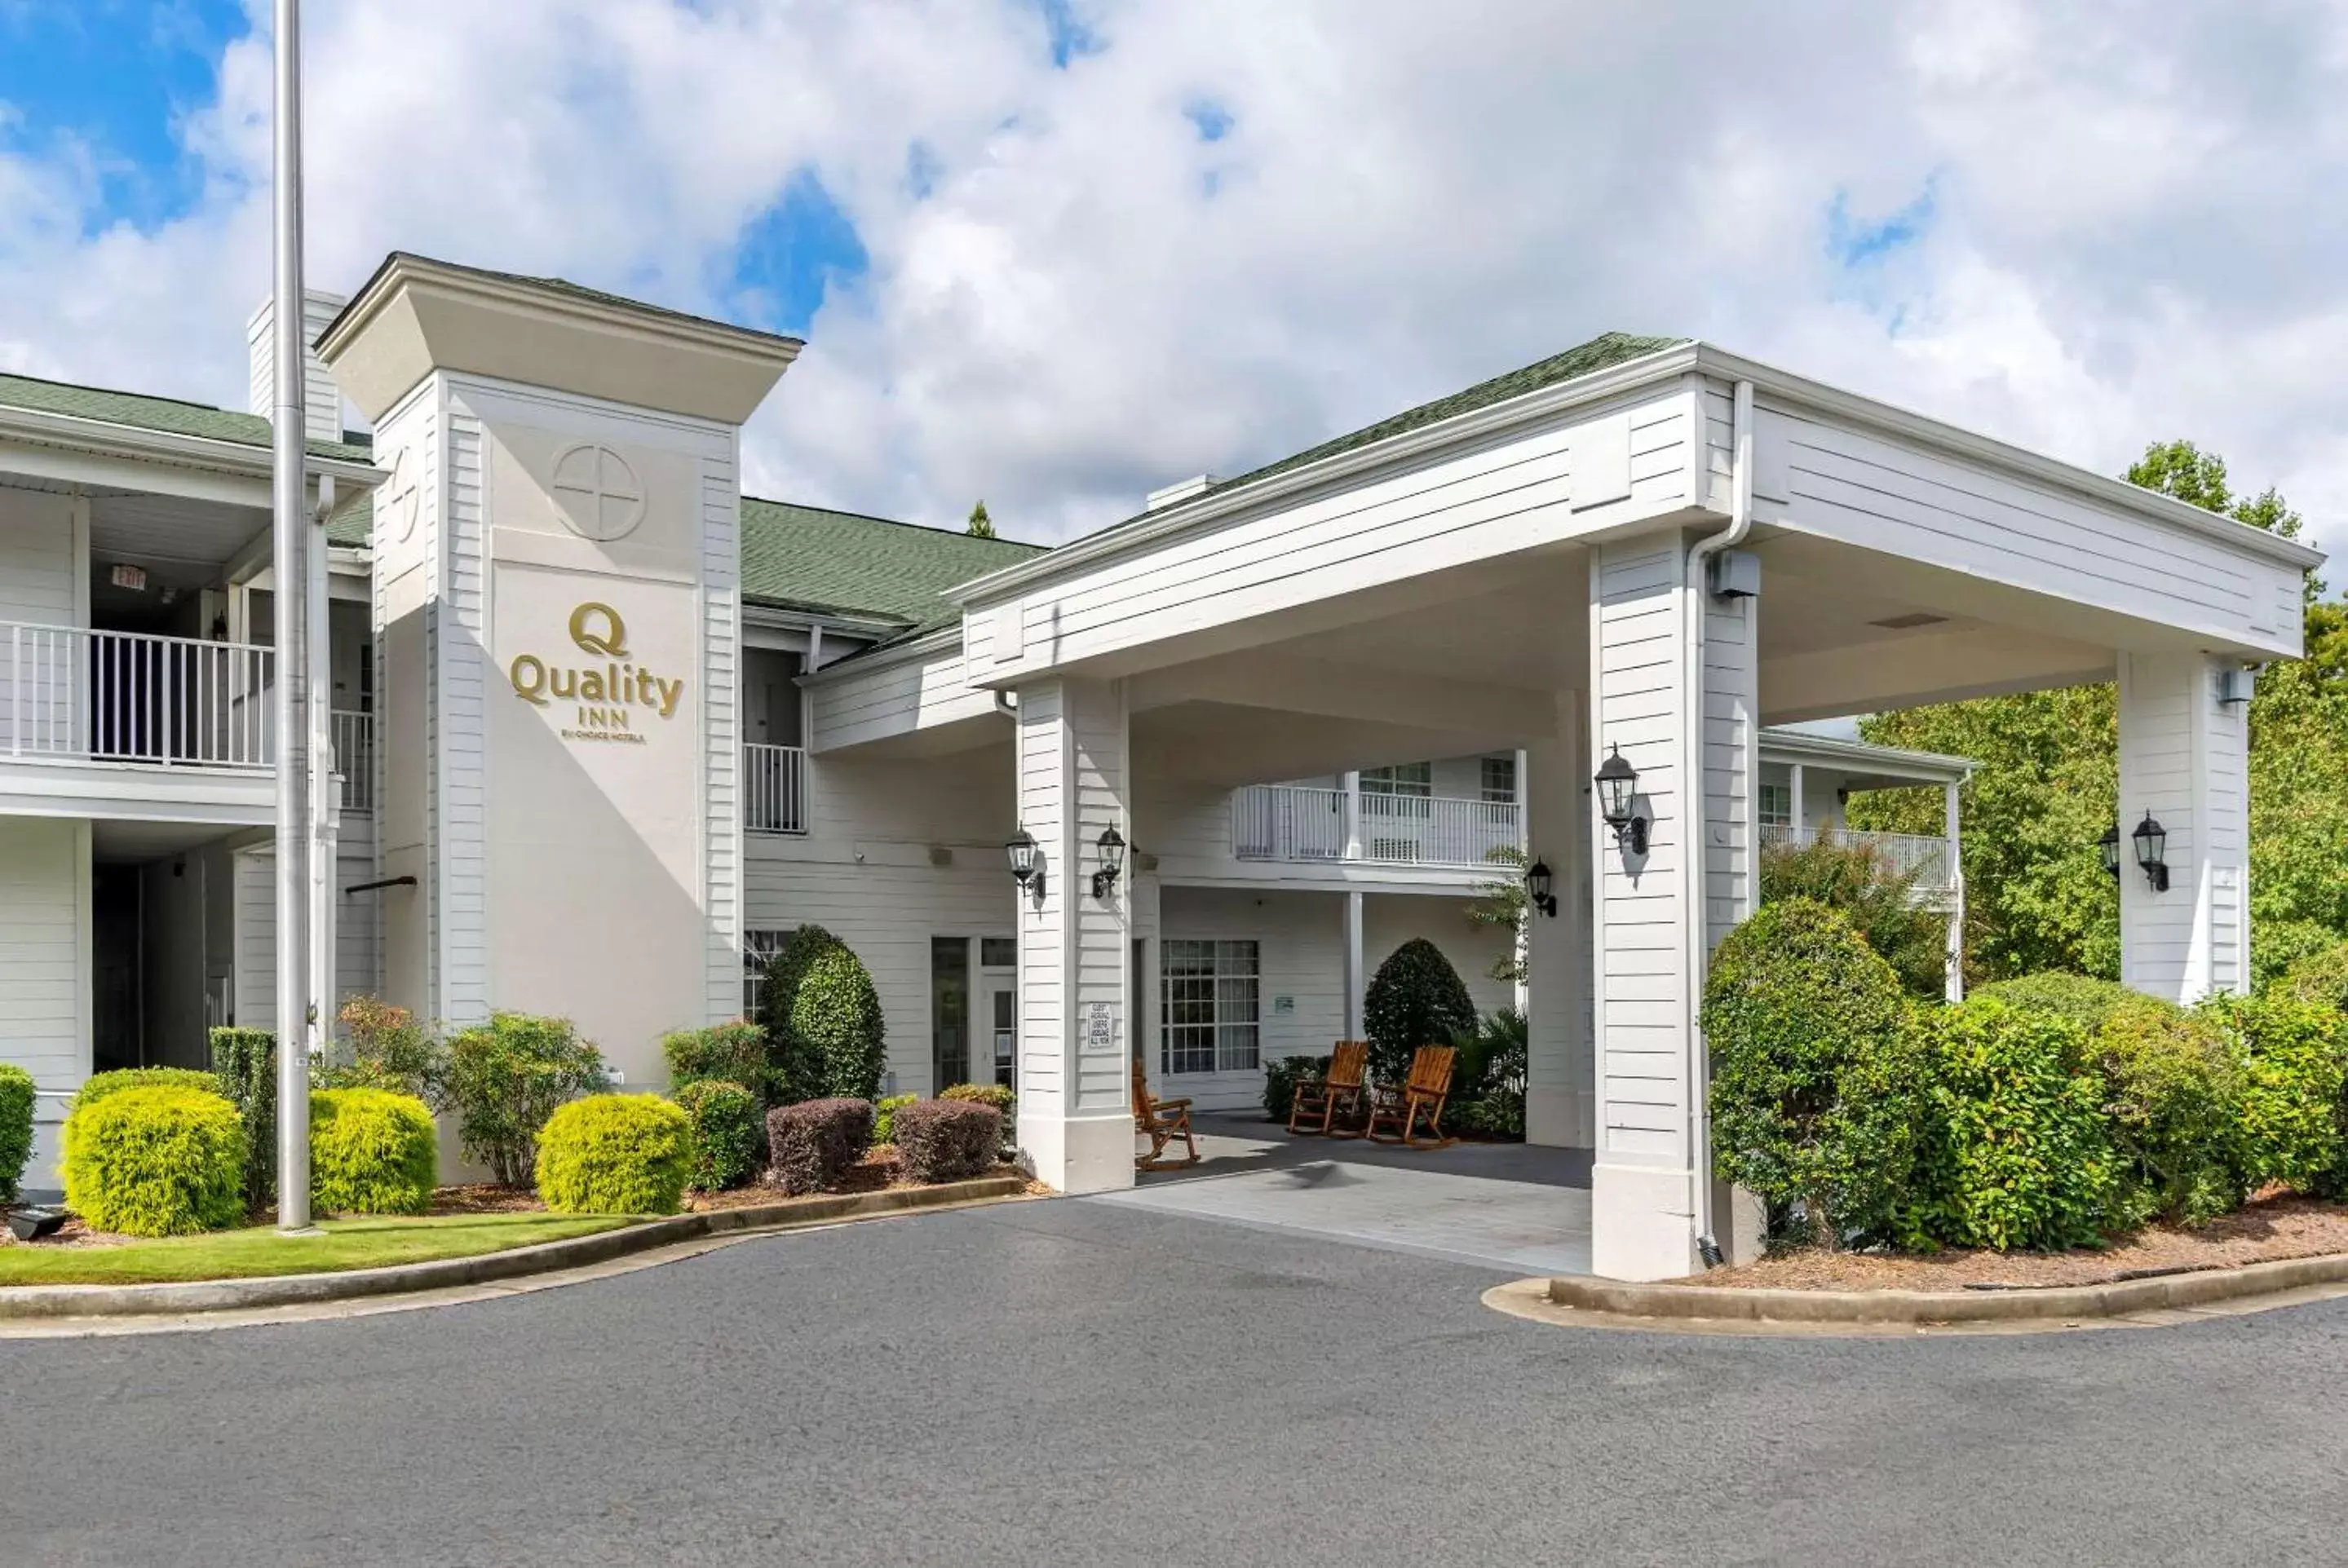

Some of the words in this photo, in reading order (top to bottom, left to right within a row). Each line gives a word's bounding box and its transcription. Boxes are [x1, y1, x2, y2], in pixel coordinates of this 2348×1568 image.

[569, 603, 629, 656] Q
[511, 655, 683, 716] Quality
[578, 707, 626, 727] INN
